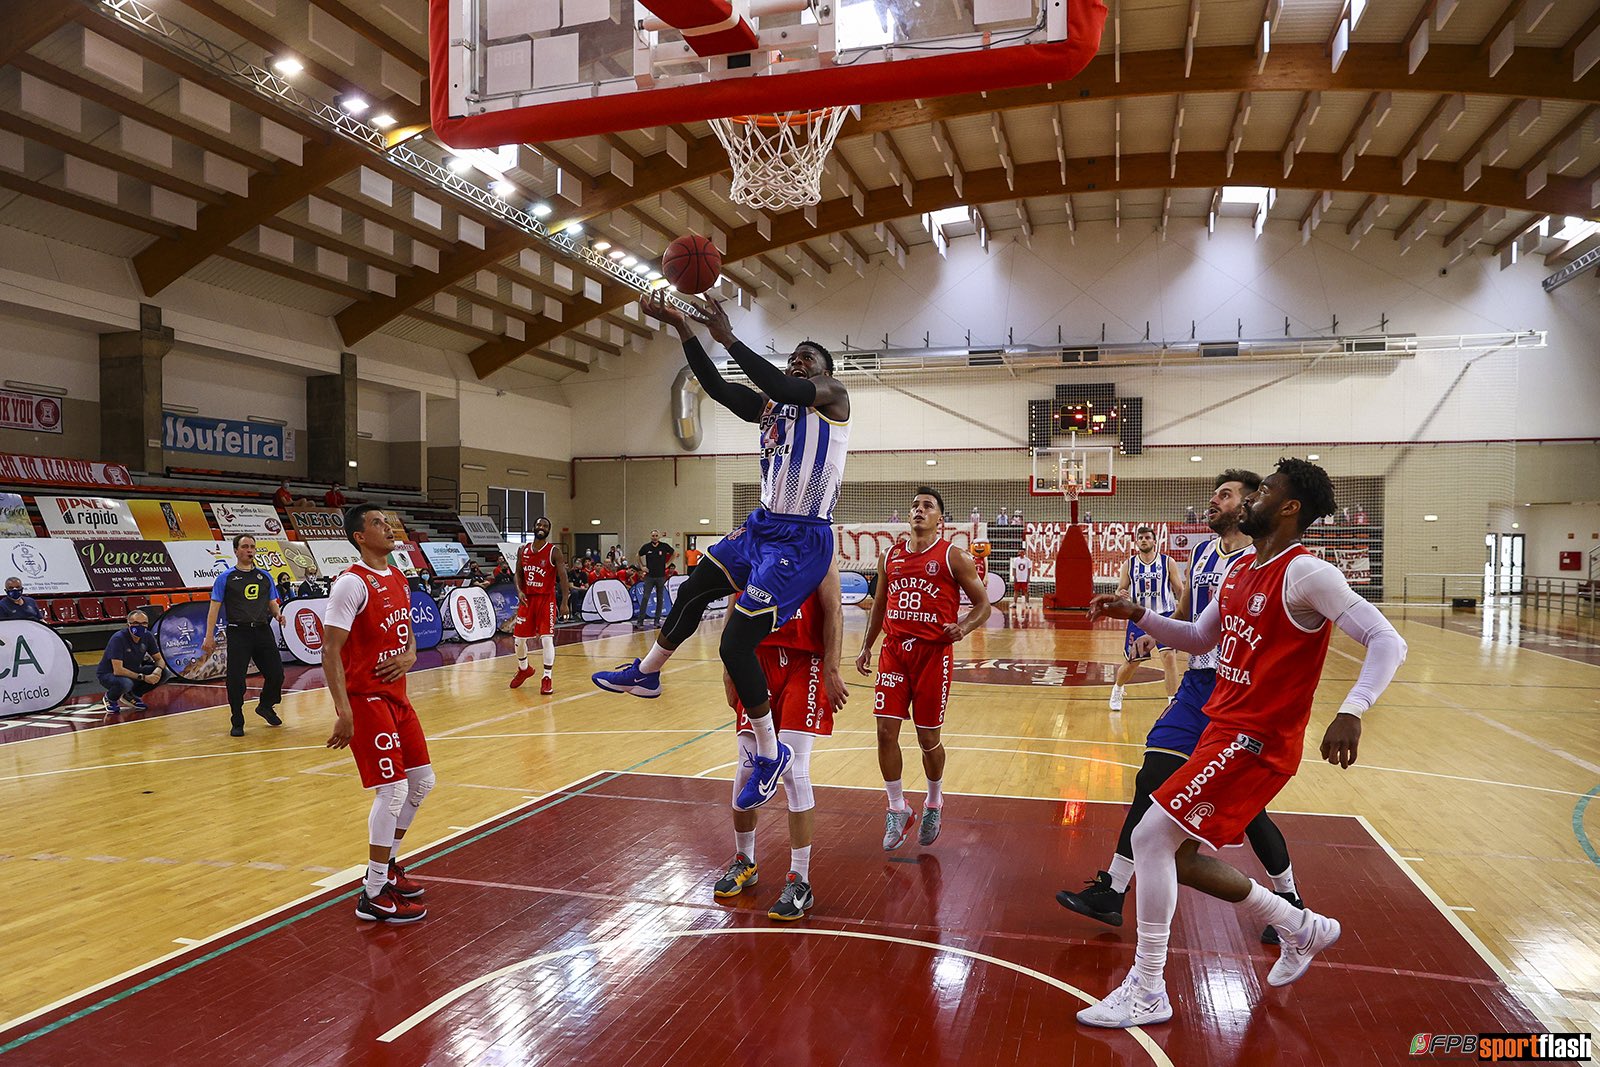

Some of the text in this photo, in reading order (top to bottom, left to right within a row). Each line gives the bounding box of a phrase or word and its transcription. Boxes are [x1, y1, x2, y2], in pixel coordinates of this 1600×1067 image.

[12, 398, 34, 424] YOU
[165, 416, 279, 457] lbufeira
[760, 444, 791, 459] EPSOL
[78, 509, 119, 529] rápido
[292, 512, 345, 527] NETO
[838, 520, 979, 561] imotal
[82, 542, 167, 566] Veneza
[93, 566, 133, 574] RESTAURANTE
[194, 568, 224, 578] Albufei
[523, 564, 547, 577] MORTAL
[1194, 572, 1222, 590] FCPO
[888, 577, 941, 599] IMORTAL
[898, 591, 922, 610] 88
[380, 607, 410, 633] IMOR
[410, 601, 434, 624] GÁS
[396, 623, 409, 645] 9
[1221, 614, 1262, 651] ORTAL
[1219, 633, 1237, 664] 10
[881, 672, 904, 683] aqua
[881, 679, 896, 688] lab
[2, 685, 50, 705] Agrícola
[806, 657, 821, 728] béricafrio
[378, 757, 395, 779] 9
[1170, 741, 1246, 810] béricafrio
